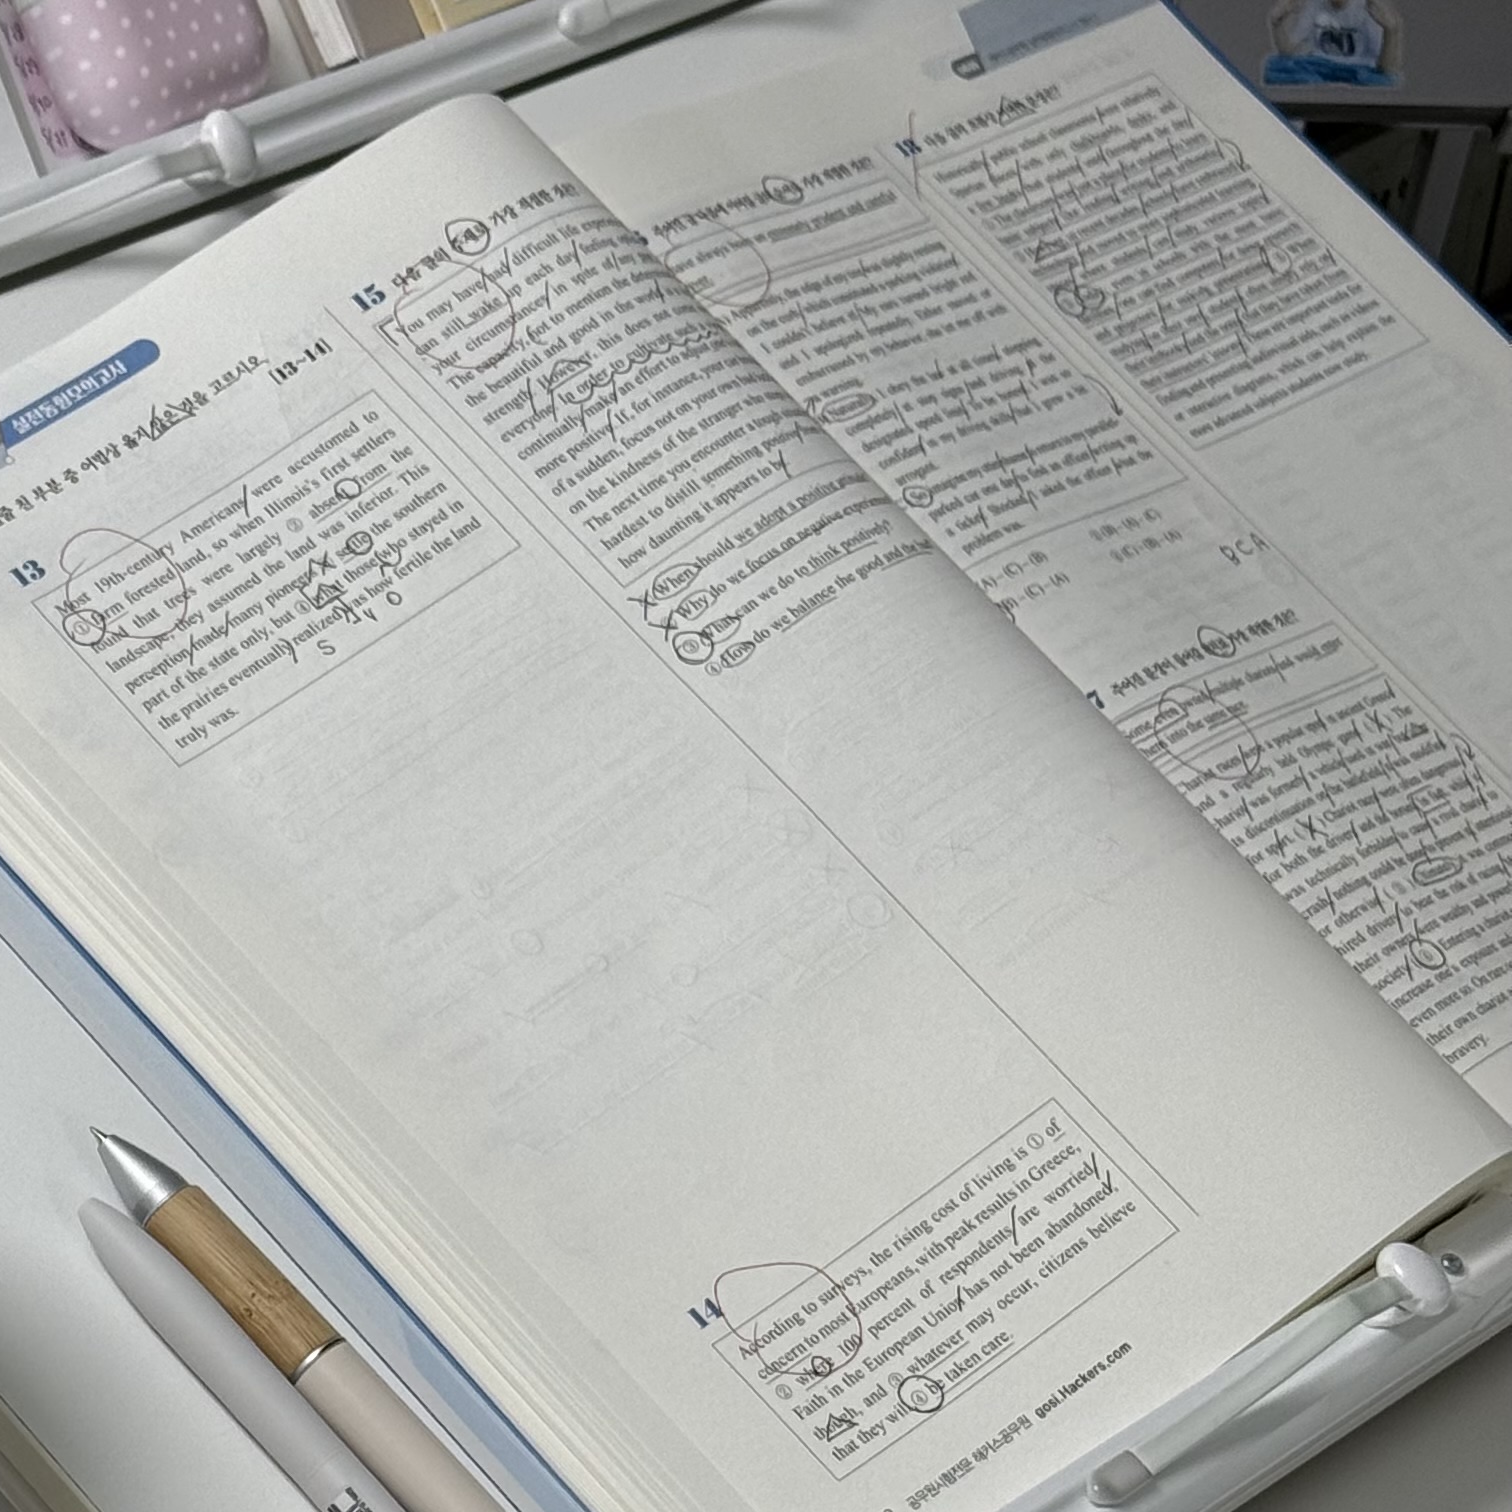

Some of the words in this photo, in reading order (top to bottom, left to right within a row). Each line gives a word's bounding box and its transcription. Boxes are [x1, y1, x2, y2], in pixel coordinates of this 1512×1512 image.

[351, 283, 387, 313] 15
[54, 592, 91, 621] Most
[93, 542, 174, 593] 19th-century
[251, 474, 282, 497] were
[287, 420, 360, 474] accustomed
[362, 411, 379, 423] to
[123, 567, 180, 604] forested
[228, 511, 265, 539] when
[263, 479, 320, 518] Illinois's
[319, 456, 350, 481] first
[350, 428, 396, 461] settlers
[392, 482, 447, 520] southern
[599, 515, 649, 550] hardest
[700, 445, 770, 486] something
[604, 448, 662, 488] kindness
[7, 558, 47, 590] 13
[206, 571, 262, 612] assumed
[396, 464, 429, 486] This
[235, 531, 281, 563] largely
[648, 509, 714, 549] daunting
[807, 544, 841, 571] think
[179, 682, 228, 720] prairies
[390, 550, 433, 579] fertile
[208, 646, 239, 670] state
[407, 507, 448, 540] stayed
[786, 584, 836, 620] balance
[174, 724, 208, 748] truly
[207, 707, 239, 727] was.
[738, 1311, 805, 1360] According
[800, 1302, 817, 1315] to
[869, 1247, 892, 1267] the
[892, 1219, 933, 1251] rising
[930, 1198, 959, 1222] cost
[971, 1157, 1016, 1190] living
[757, 1342, 807, 1384] concern
[817, 1311, 850, 1338] most
[914, 1241, 947, 1265] with
[943, 1218, 977, 1250] peak
[973, 1189, 1017, 1224] results
[1027, 1145, 1081, 1181] Greece,
[862, 1382, 888, 1407] and
[906, 1329, 964, 1378] whatever
[965, 1307, 994, 1333] may
[1038, 1237, 1088, 1278] citizens
[1086, 1201, 1136, 1239] believe
[867, 1297, 916, 1340] percent
[1012, 1205, 1039, 1226] are
[687, 1297, 724, 1332] 14
[791, 1393, 829, 1420] Faith
[841, 1368, 865, 1387] the
[861, 1325, 926, 1372] European
[957, 1277, 989, 1299] has
[988, 1259, 1013, 1281] not
[1008, 1236, 1045, 1263] been
[831, 1439, 859, 1461] that
[856, 1419, 886, 1444] they
[943, 1352, 982, 1382] taken
[1034, 1342, 1131, 1418] gosi.Hackers.com
